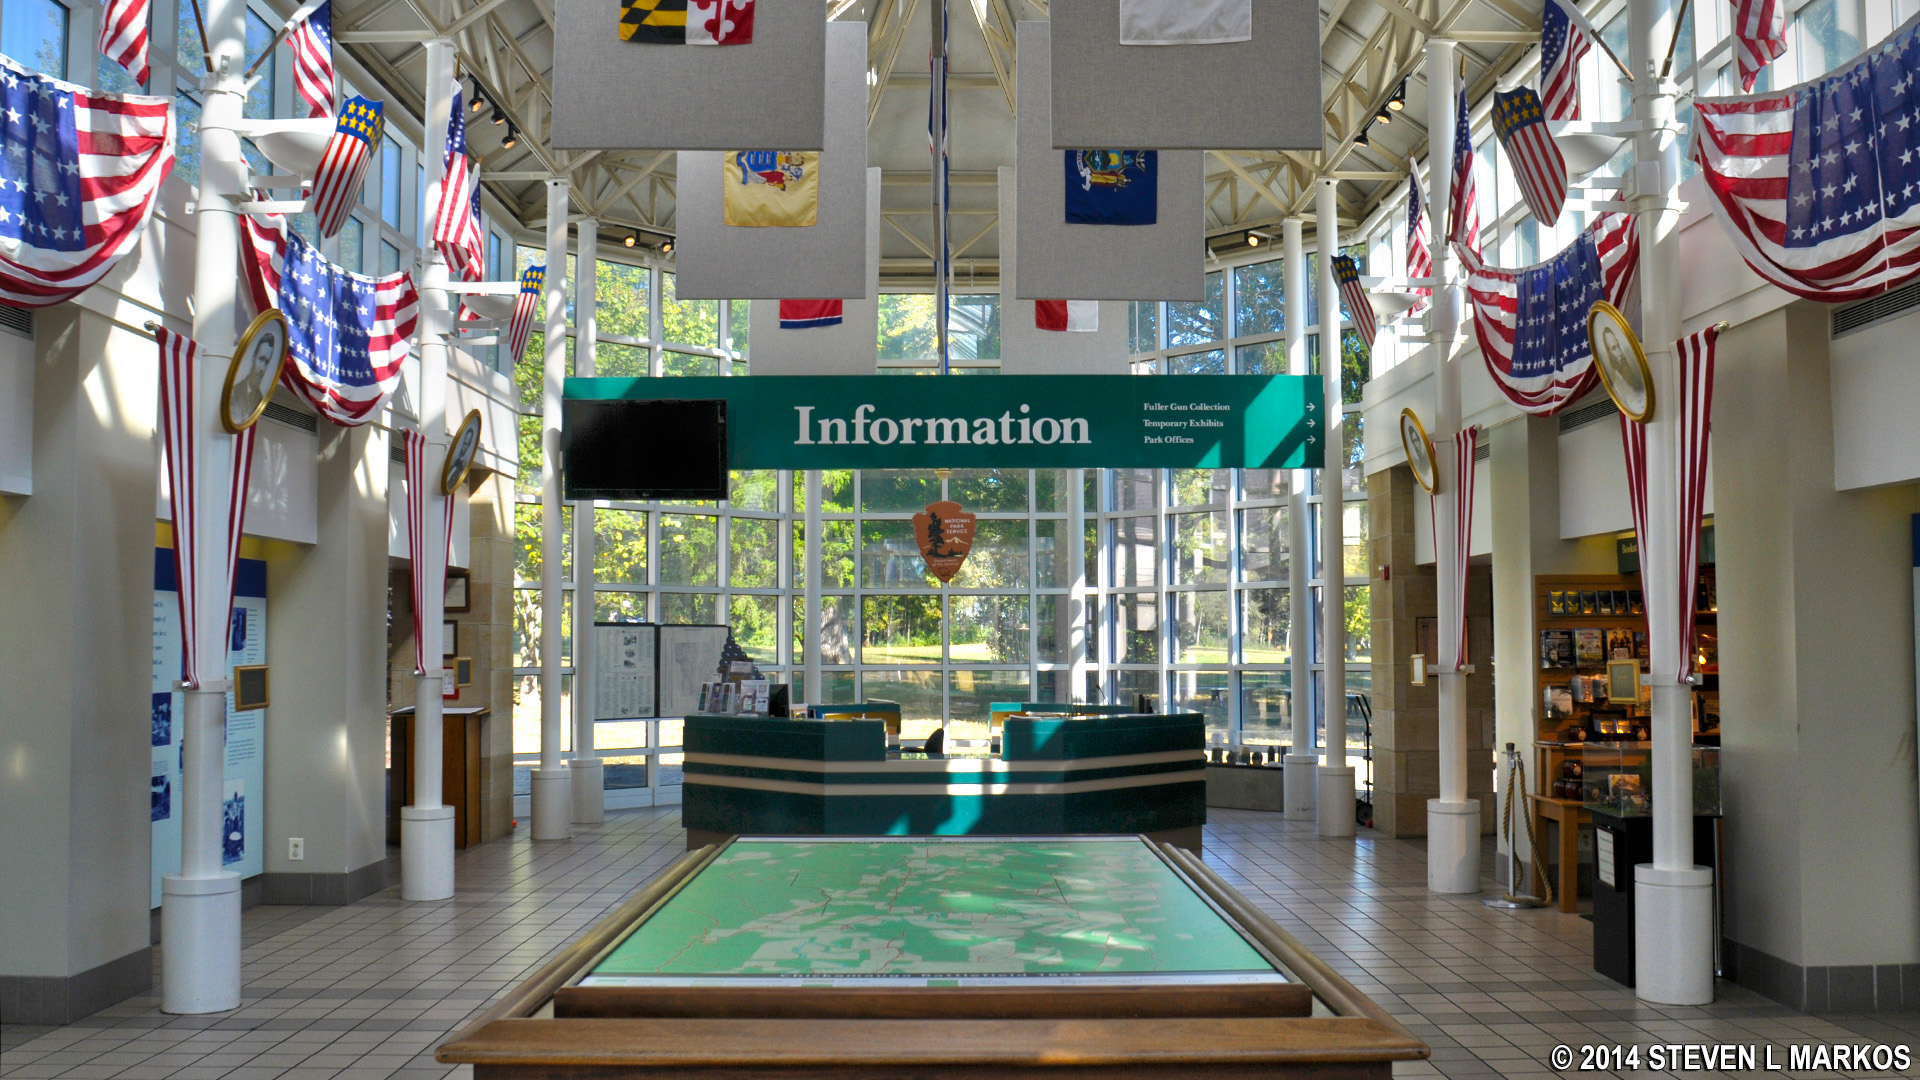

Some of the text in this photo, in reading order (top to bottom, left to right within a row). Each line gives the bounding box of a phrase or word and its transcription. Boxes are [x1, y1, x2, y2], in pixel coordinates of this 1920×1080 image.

[1143, 402, 1231, 411] Fuller Gun Collection
[794, 404, 1092, 445] Information
[1142, 419, 1224, 429] Temporary Exhibits
[1144, 435, 1194, 444] Park Offices
